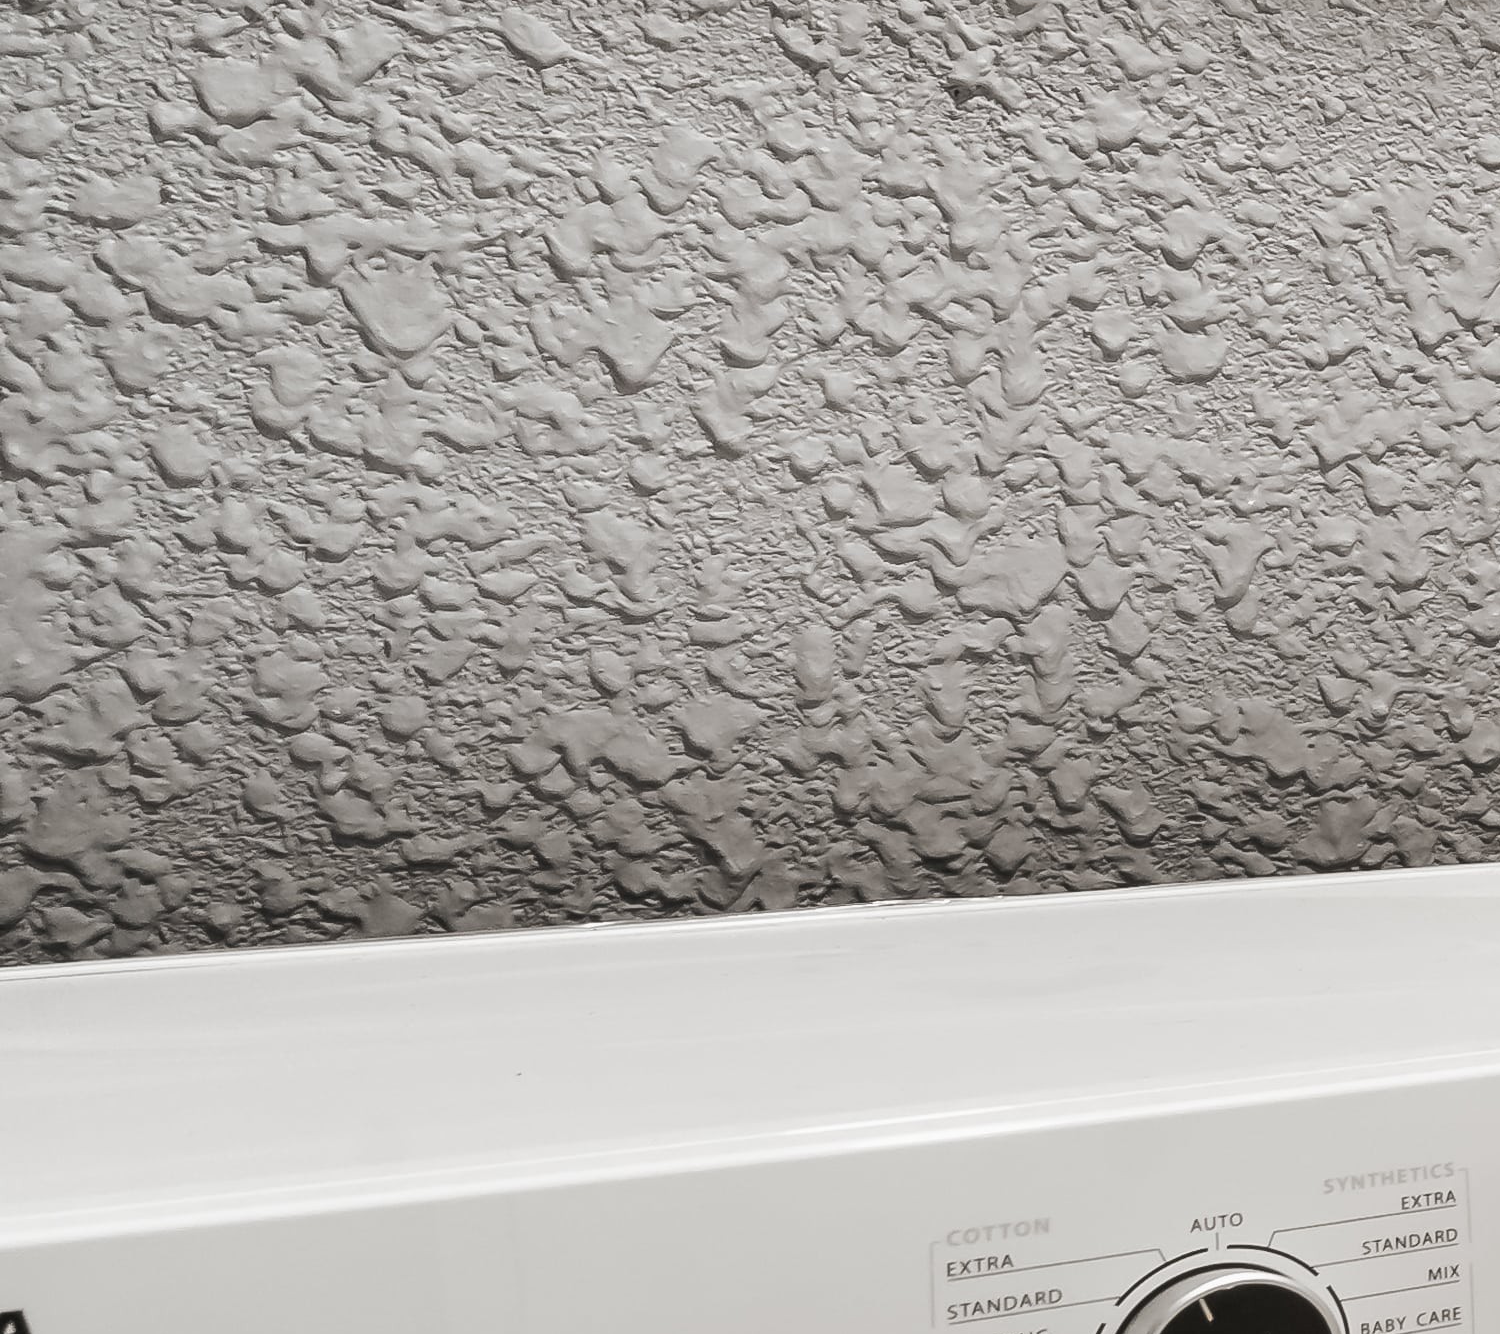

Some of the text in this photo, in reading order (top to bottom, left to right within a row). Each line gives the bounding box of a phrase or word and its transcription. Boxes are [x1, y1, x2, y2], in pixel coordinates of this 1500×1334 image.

[1323, 1162, 1454, 1195] SYNTHETICS
[1401, 1190, 1456, 1210] EXTRA
[946, 1217, 1051, 1246] COTTON
[1190, 1213, 1243, 1233] AUTO
[1362, 1228, 1458, 1255] STANDARD
[947, 1254, 1014, 1277] EXTRA
[1428, 1264, 1460, 1281] MIX
[947, 1288, 1062, 1320] STANDARD
[1416, 1307, 1461, 1326] CARE
